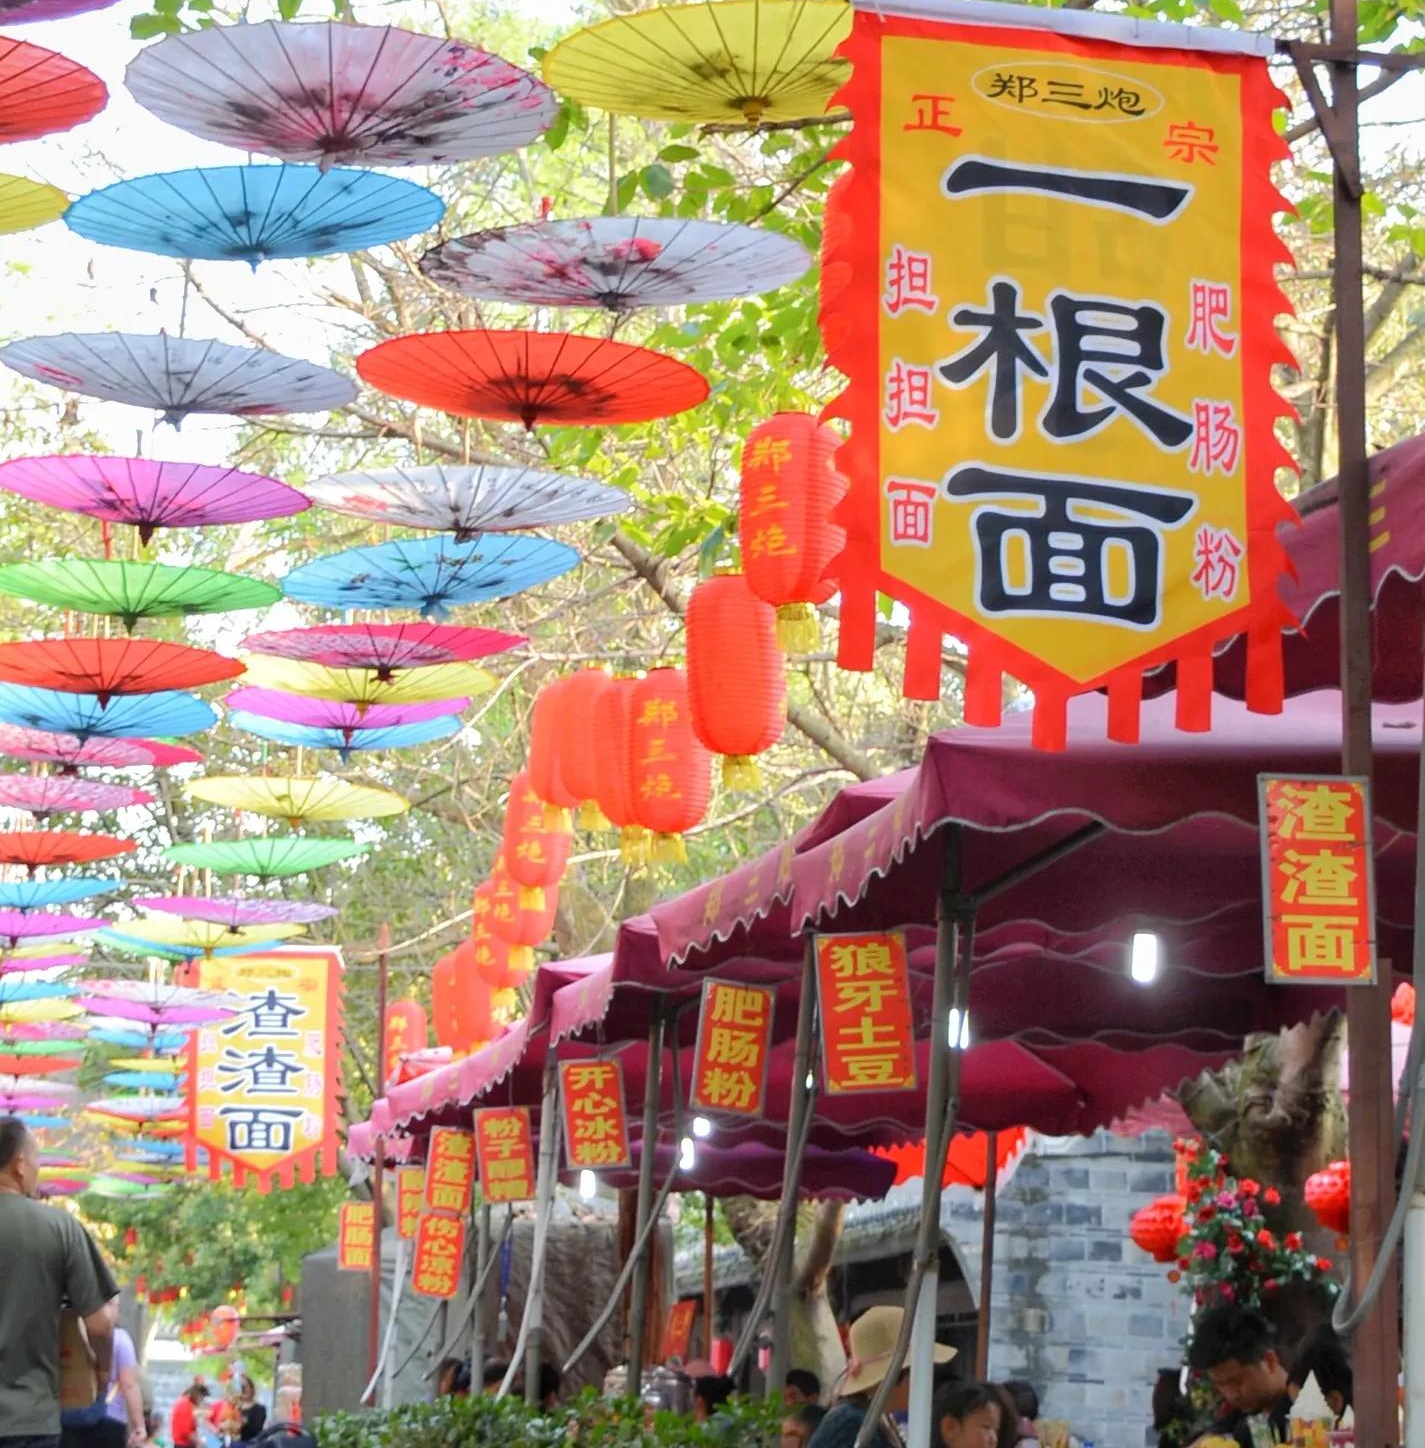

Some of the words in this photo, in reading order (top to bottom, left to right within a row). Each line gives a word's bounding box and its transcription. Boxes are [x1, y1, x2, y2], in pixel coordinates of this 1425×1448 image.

[902, 93, 964, 138] 正
[1162, 120, 1220, 166] 宗
[986, 71, 1146, 117] 郑三炮
[884, 249, 938, 545] 担担面
[938, 159, 1195, 627] 一根面
[1185, 282, 1242, 600] 肥肠粉
[748, 436, 798, 559] 郑三炮
[1277, 783, 1360, 972] 渣渣面
[216, 988, 308, 1152] 渣渣面
[702, 988, 764, 1109] 肥肠粉
[829, 944, 904, 1087] 狼牙土豆
[431, 1133, 470, 1209] 渣渣面
[567, 1065, 622, 1166] 开心冰粉
